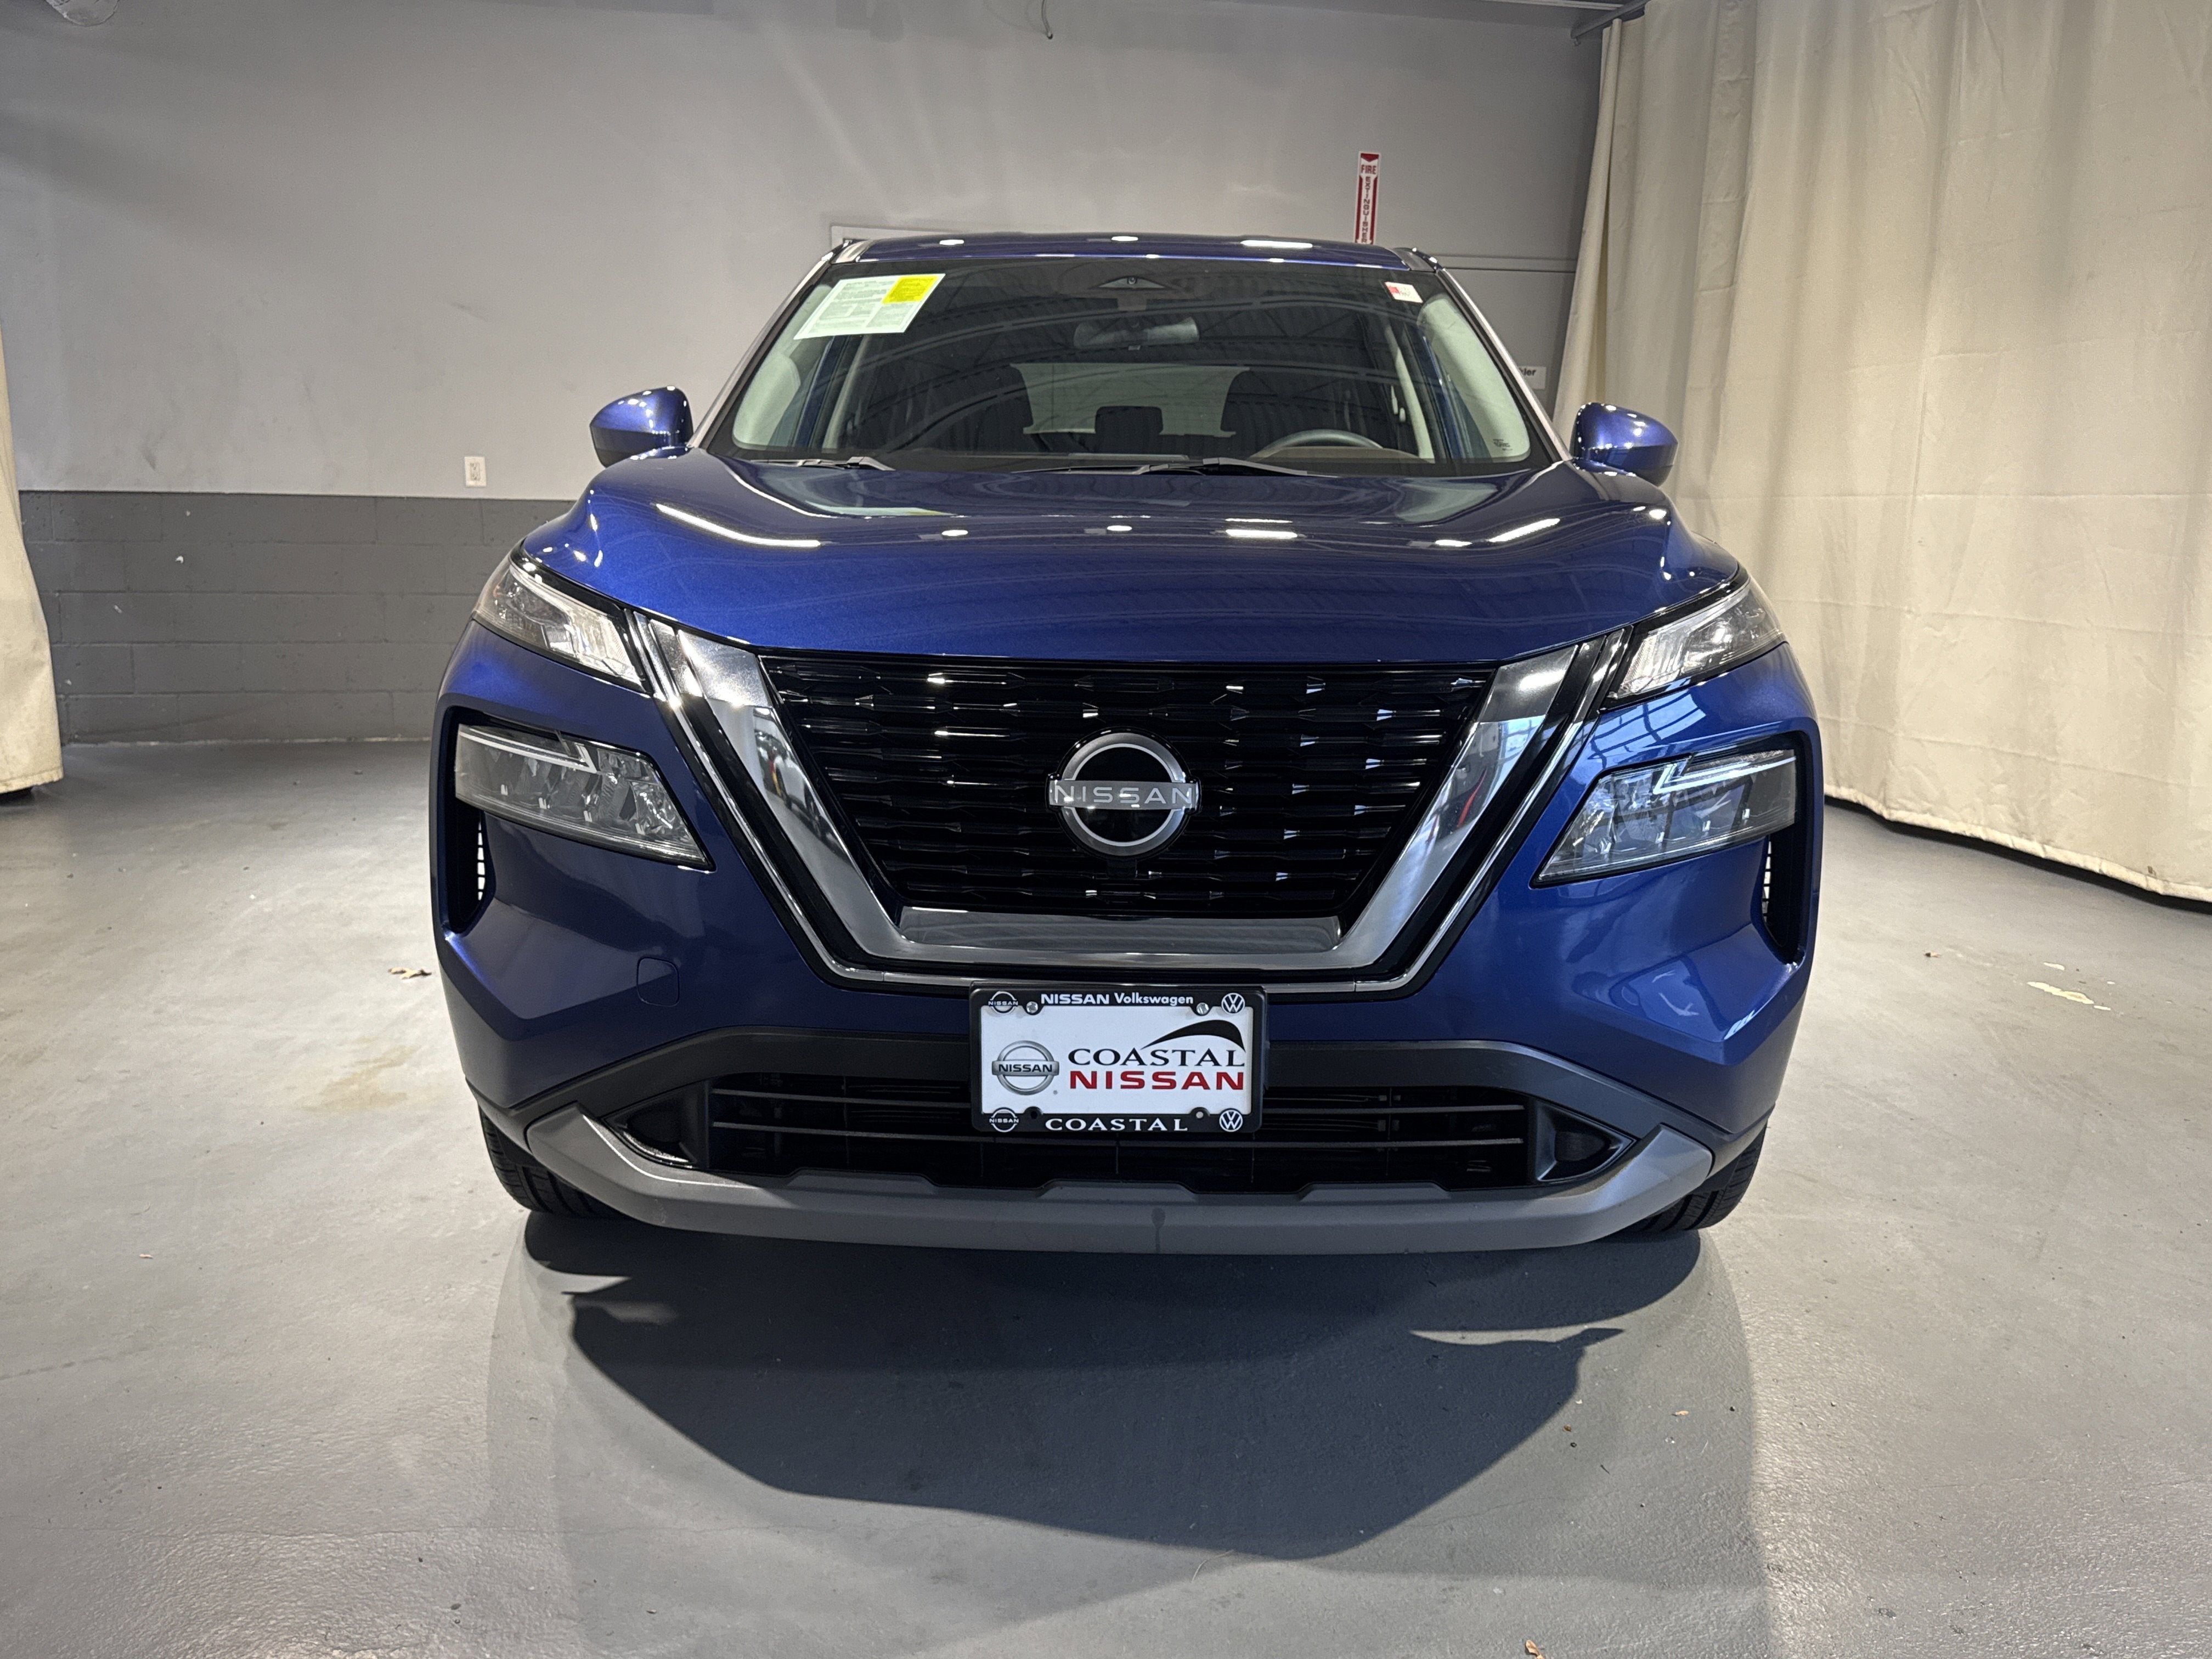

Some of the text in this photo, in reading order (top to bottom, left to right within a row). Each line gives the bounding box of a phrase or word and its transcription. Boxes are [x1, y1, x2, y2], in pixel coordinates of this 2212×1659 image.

[1361, 165, 1376, 174] FIRE
[1362, 177, 1371, 242] EXTINGUISHER
[1054, 785, 1192, 804] NISSAN
[1041, 992, 1194, 1006] NISSAN Volkswagen
[1222, 994, 1244, 1013] VW
[1068, 1048, 1245, 1067] COASTAL
[998, 1063, 1053, 1074] NISSAN
[1069, 1070, 1244, 1091] NISSAN
[1045, 1118, 1188, 1132] COASTAL
[1220, 1110, 1242, 1131] VW
